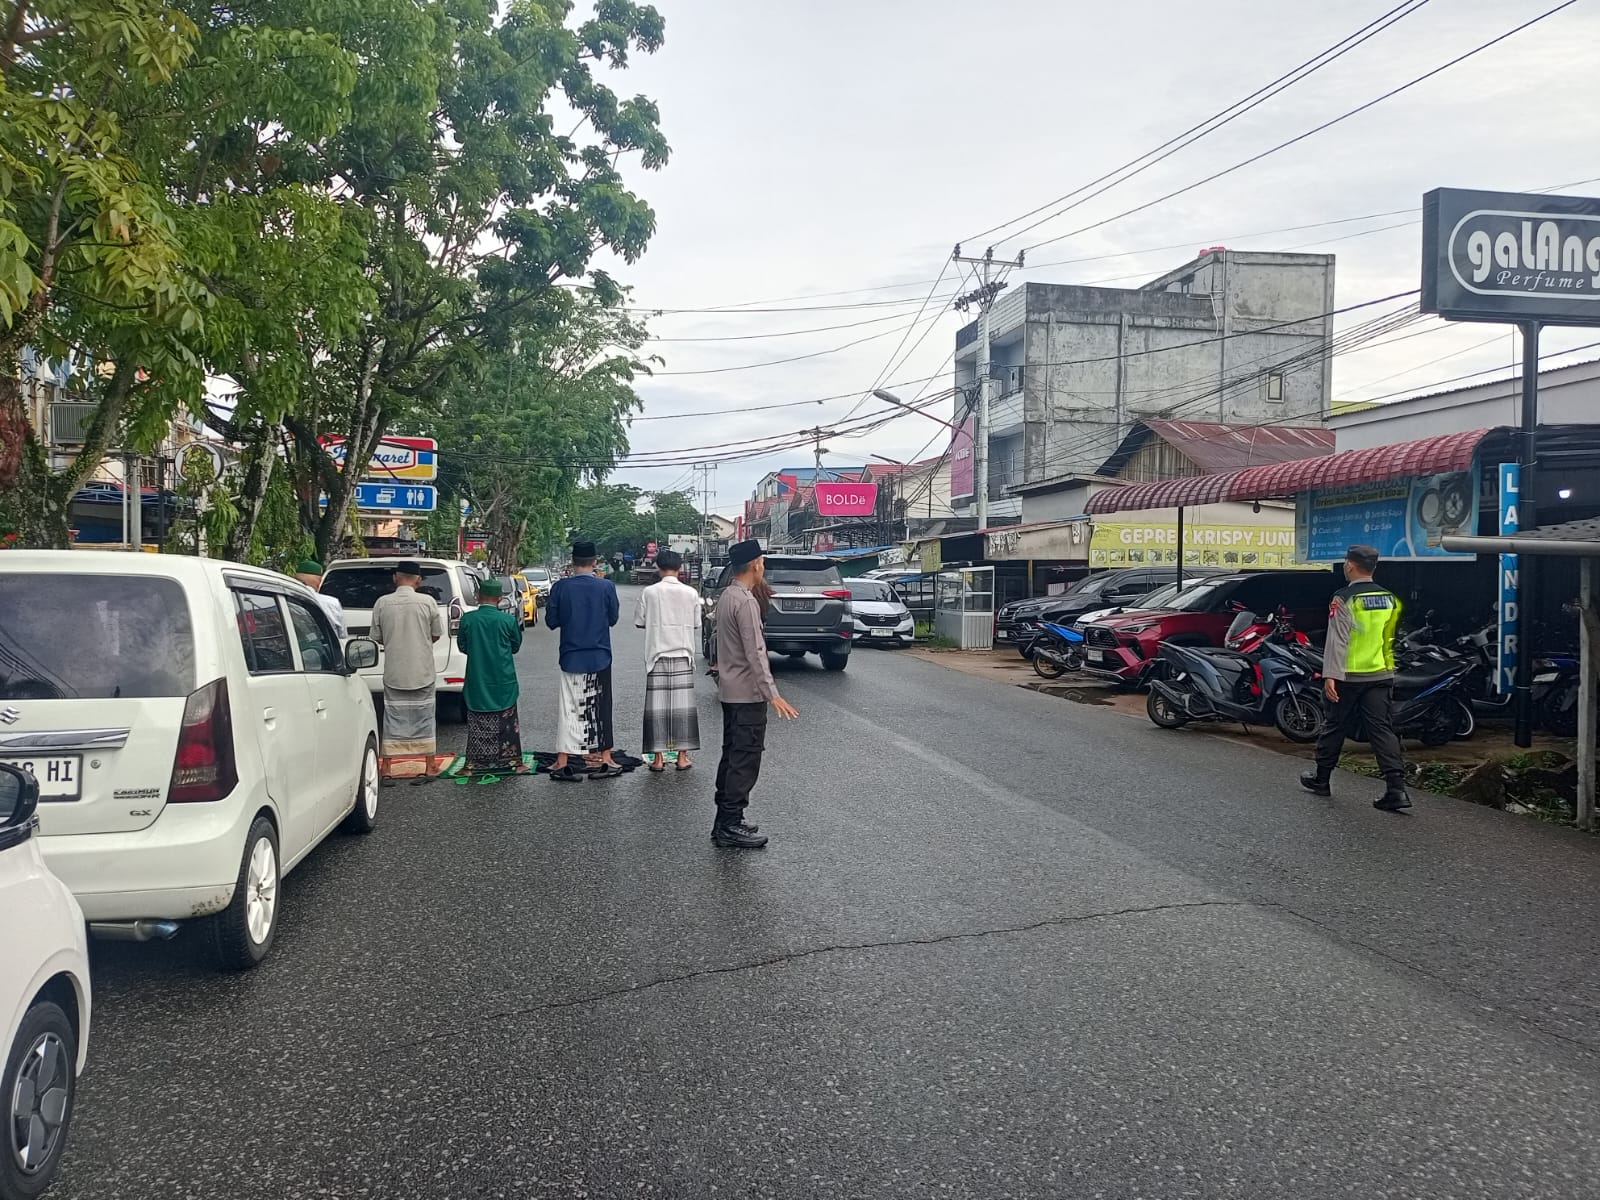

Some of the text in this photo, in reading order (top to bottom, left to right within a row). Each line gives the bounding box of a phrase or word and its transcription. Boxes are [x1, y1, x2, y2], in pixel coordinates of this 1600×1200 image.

[1496, 270, 1585, 291] Perfume
[1193, 529, 1254, 546] KRISPY
[47, 760, 73, 782] HI
[129, 809, 152, 817] GX
